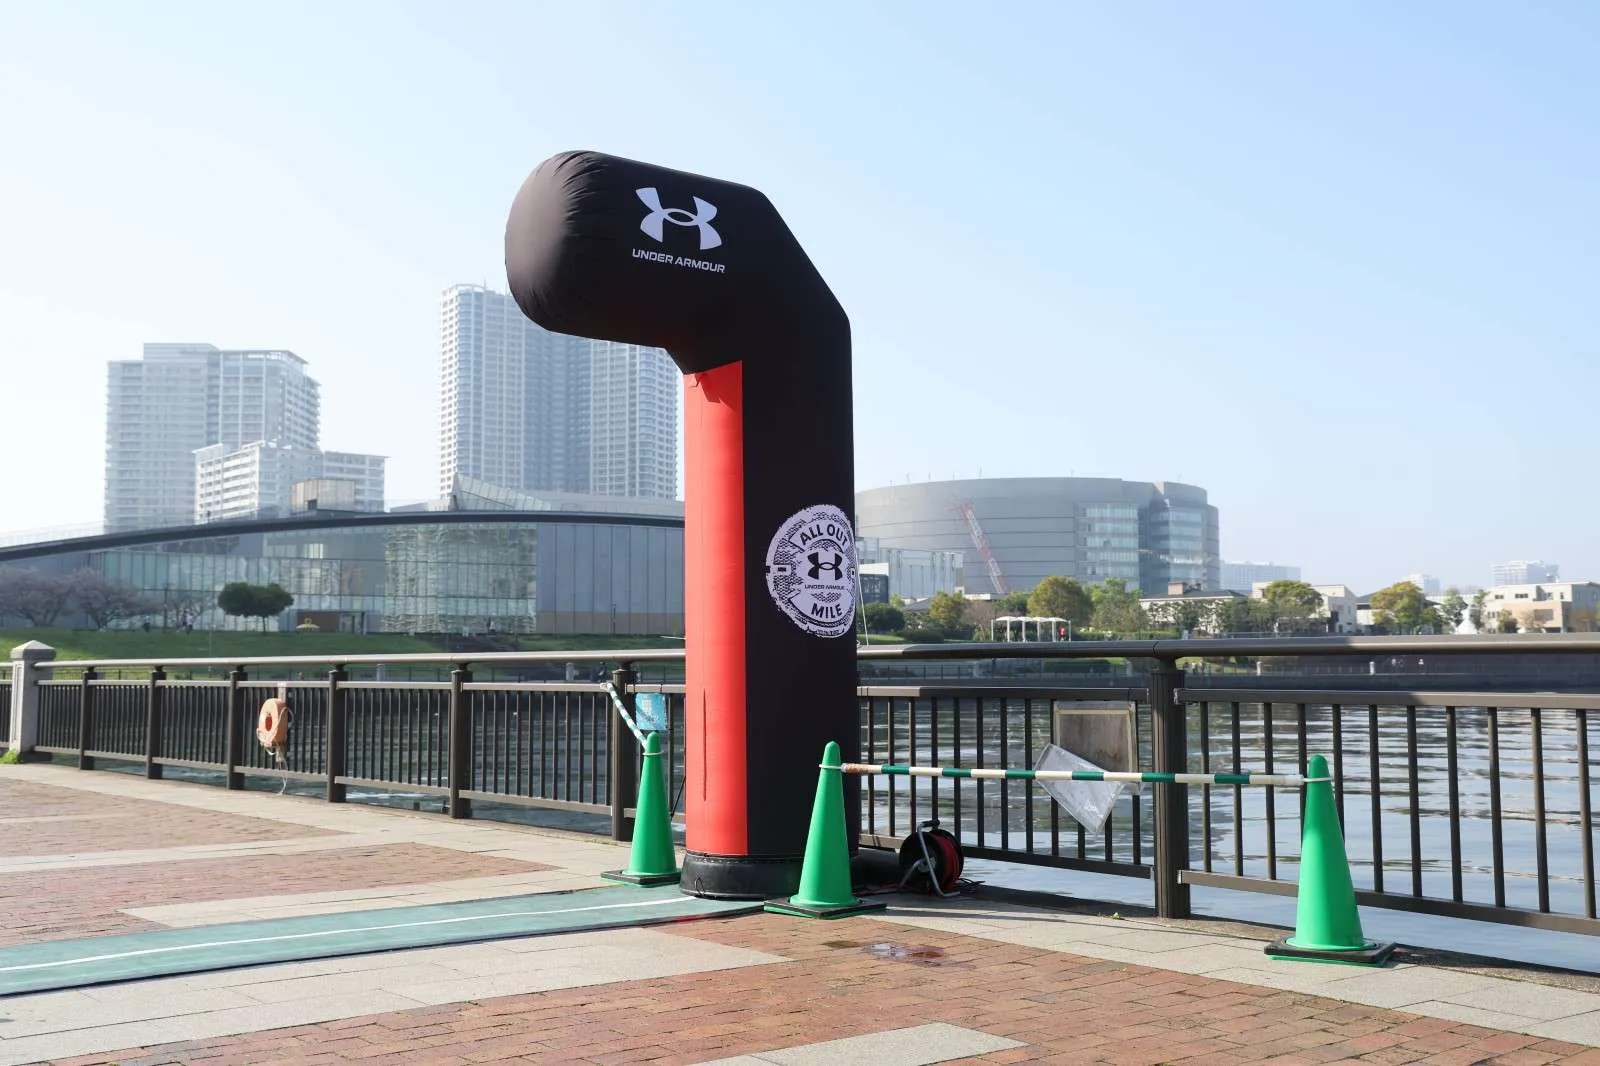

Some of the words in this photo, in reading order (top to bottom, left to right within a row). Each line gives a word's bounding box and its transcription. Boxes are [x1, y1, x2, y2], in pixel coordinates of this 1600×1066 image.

[632, 248, 673, 265] UNDER
[674, 256, 726, 274] ARMOUR
[800, 524, 823, 546] ALL
[826, 523, 848, 546] OUT
[811, 602, 842, 619] MILE
